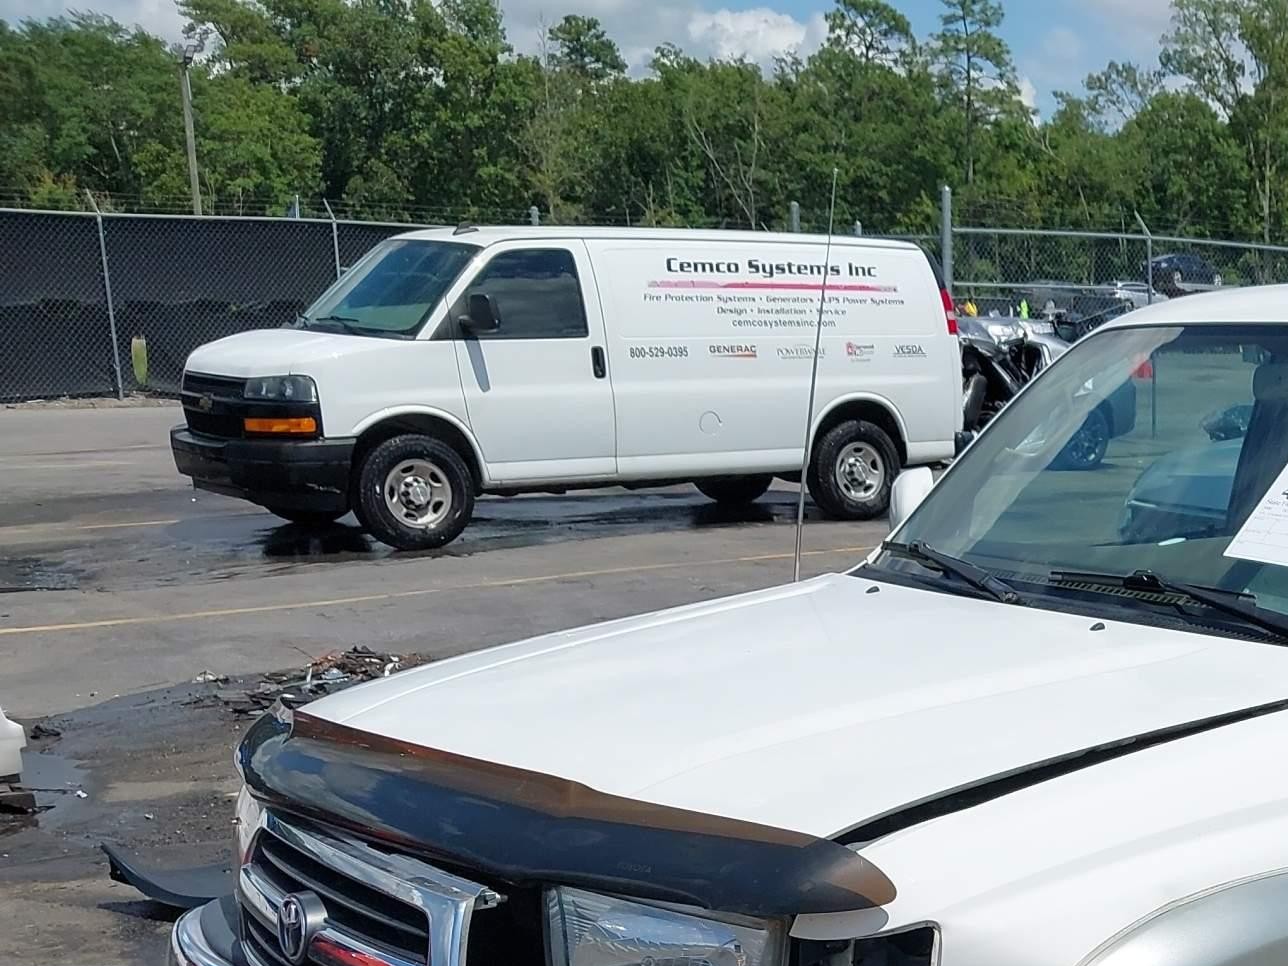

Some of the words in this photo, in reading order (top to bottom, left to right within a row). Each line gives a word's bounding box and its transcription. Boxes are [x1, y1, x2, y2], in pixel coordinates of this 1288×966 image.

[666, 257, 740, 274] Cemco
[747, 259, 841, 278] Systems
[848, 262, 877, 278] Inc
[643, 293, 662, 302] Fire
[664, 293, 714, 302] Protection
[716, 294, 756, 304] Systems
[766, 295, 814, 303] Generators
[842, 296, 867, 305] Power
[870, 297, 905, 307] Systems
[716, 306, 748, 316] Design
[757, 307, 807, 315] Installation
[732, 319, 837, 328] cemcosystemsinc.om
[629, 346, 689, 359] 800-529-0395
[708, 345, 757, 354] GENERAC
[894, 344, 924, 354] VESDA
